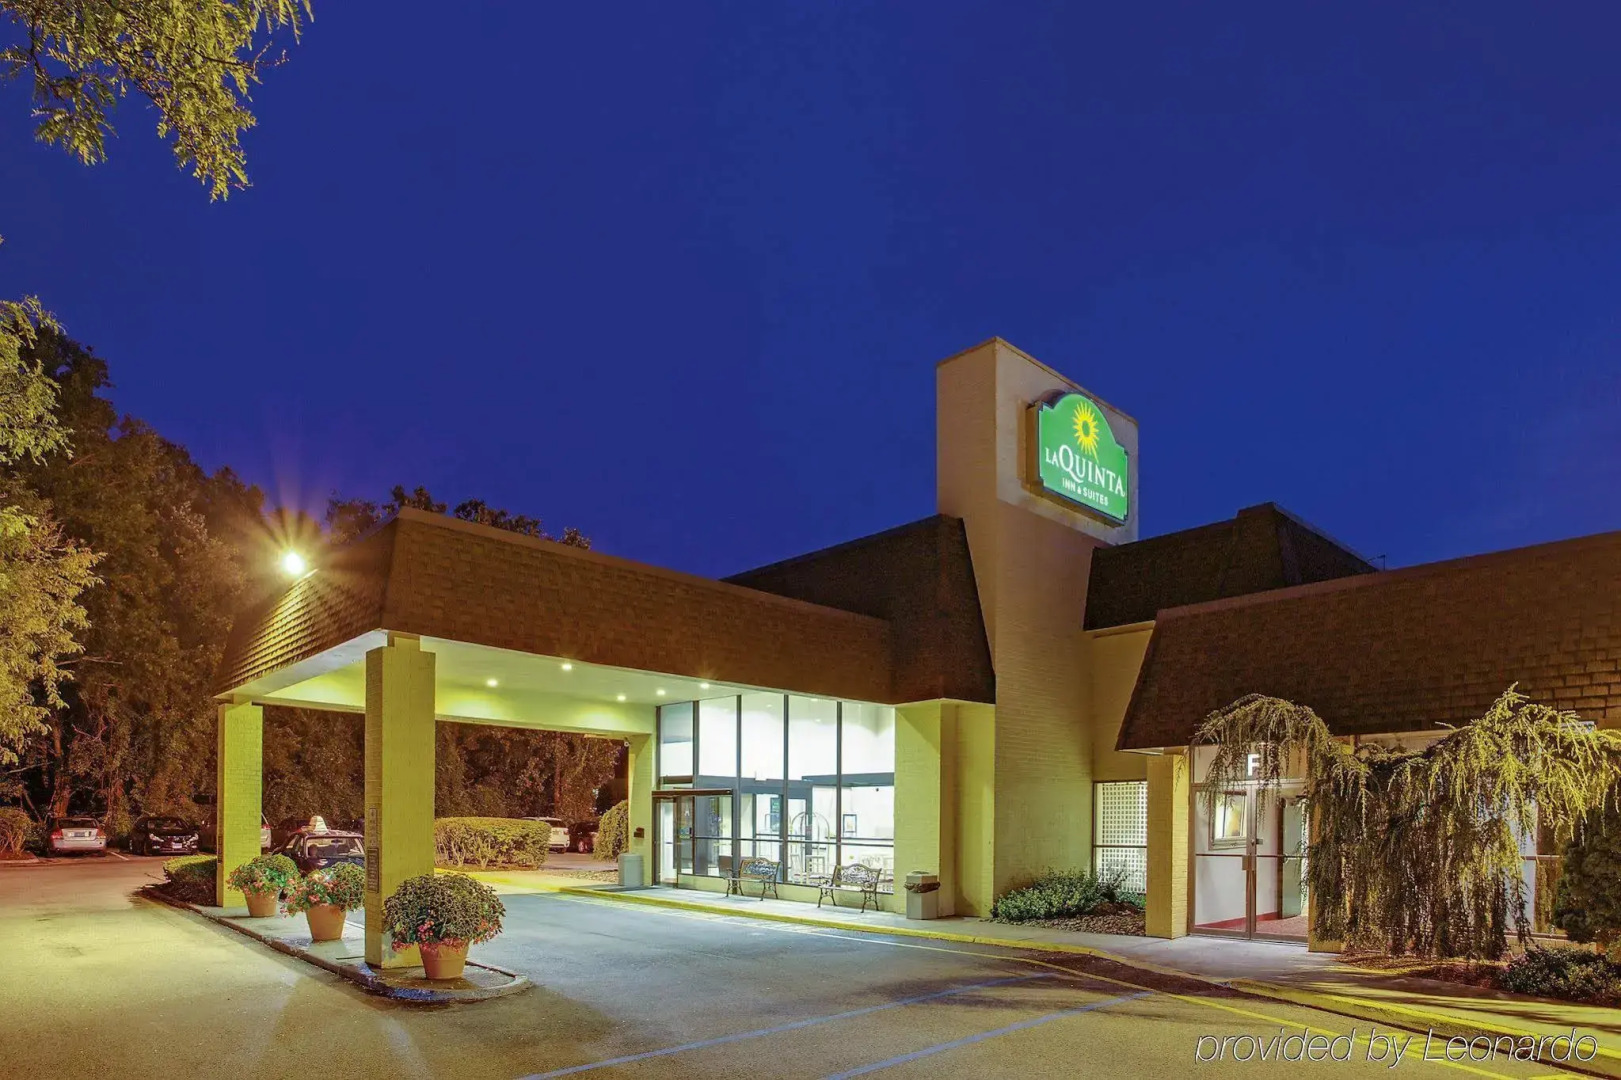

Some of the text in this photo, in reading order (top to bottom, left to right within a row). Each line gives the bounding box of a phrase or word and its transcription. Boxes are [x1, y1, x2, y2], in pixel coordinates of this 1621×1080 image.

[1062, 478, 1108, 506] INN & SUITES
[1247, 753, 1260, 776] F
